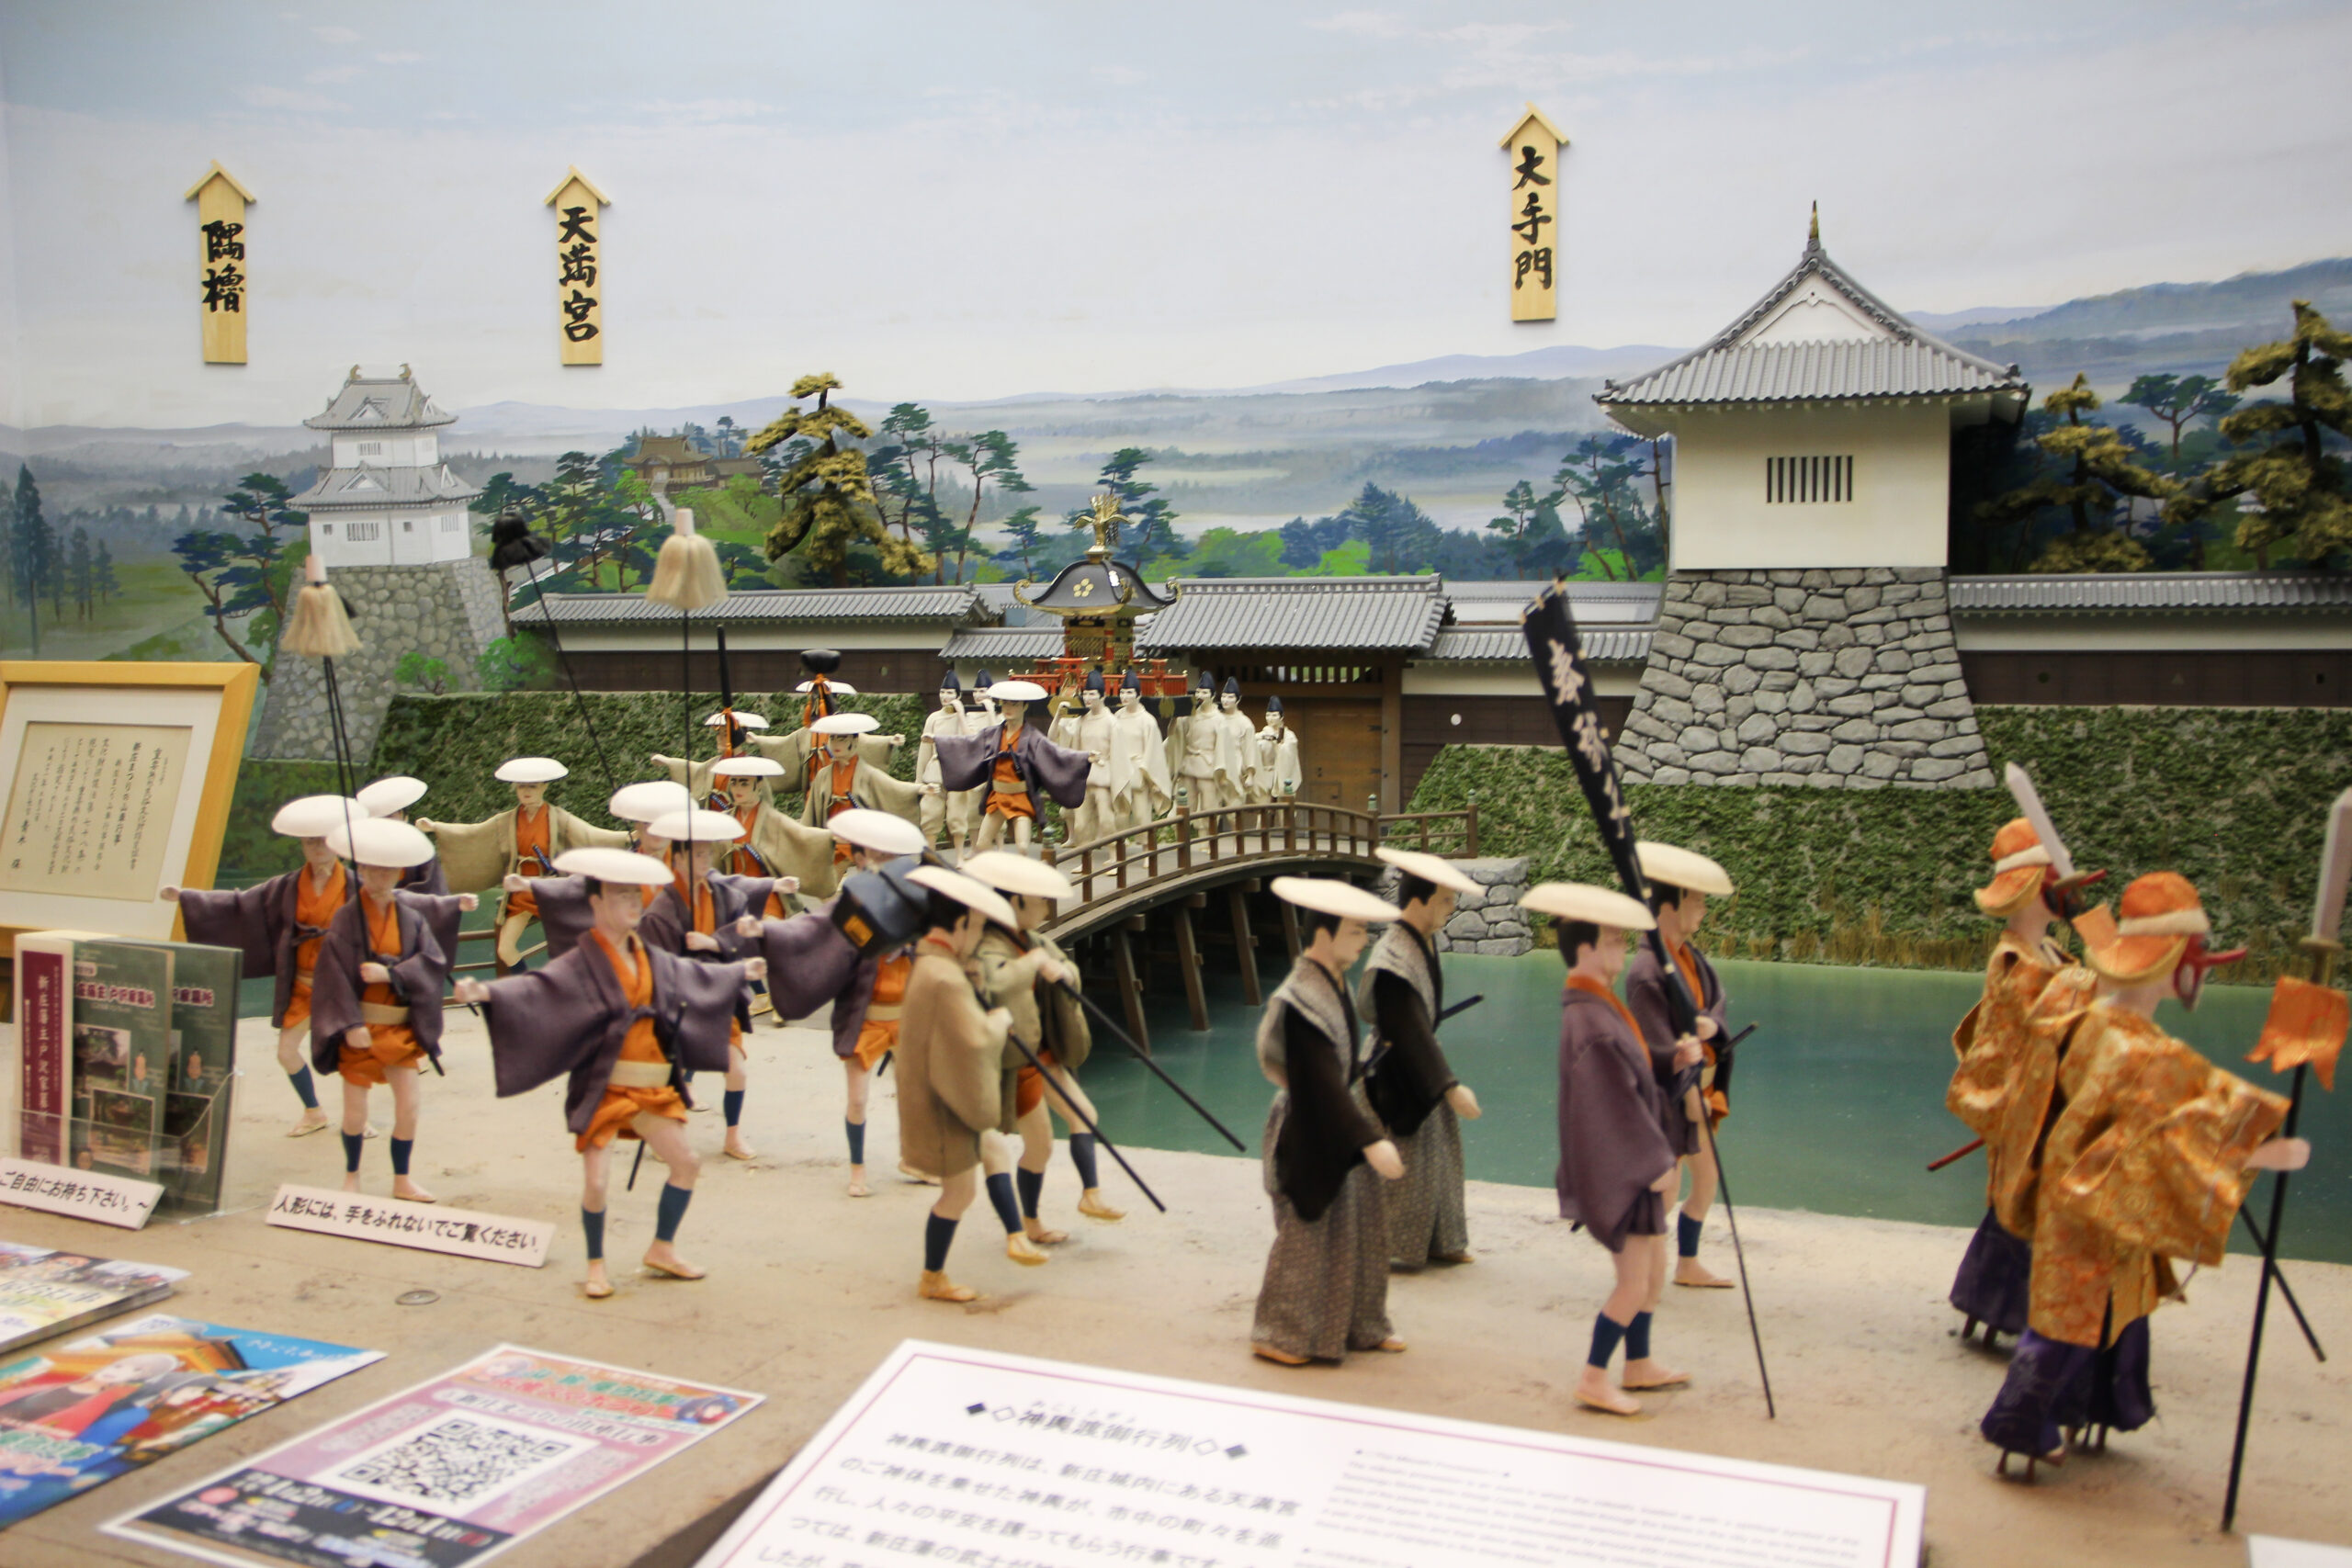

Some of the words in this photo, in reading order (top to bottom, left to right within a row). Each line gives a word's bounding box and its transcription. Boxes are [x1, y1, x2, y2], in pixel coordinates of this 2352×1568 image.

[201, 220, 244, 313] 隅櫓
[559, 206, 599, 342] 天満宮
[1511, 145, 1553, 289] 大手門
